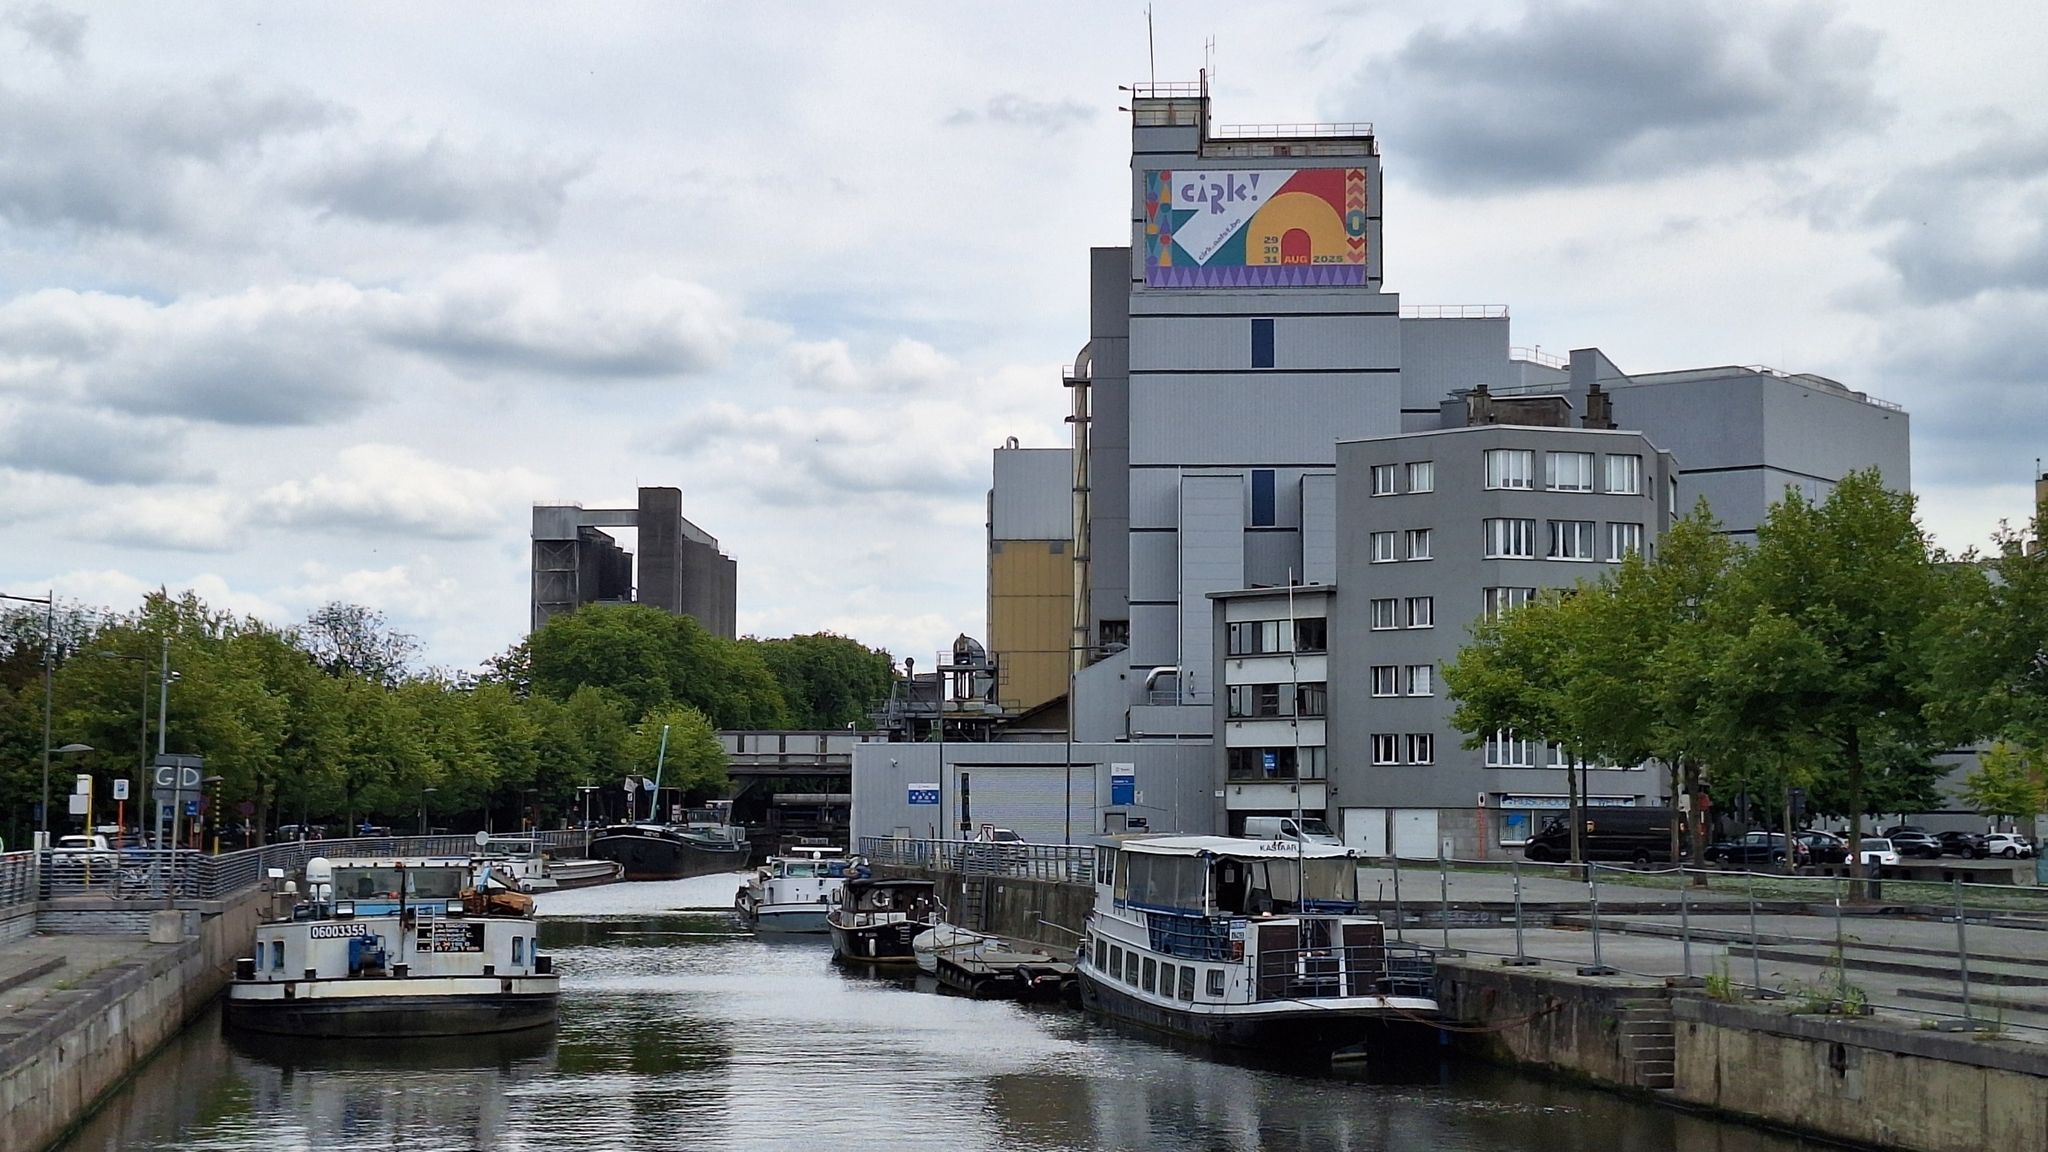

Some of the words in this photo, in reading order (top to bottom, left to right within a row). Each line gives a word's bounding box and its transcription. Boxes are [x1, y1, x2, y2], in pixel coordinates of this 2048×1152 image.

[1264, 236, 1279, 244] 29
[1264, 246, 1279, 254] 30
[1263, 256, 1278, 264] 31
[1284, 255, 1308, 264] AUG
[1313, 255, 1344, 263] 2025
[312, 924, 365, 938] 06003355
